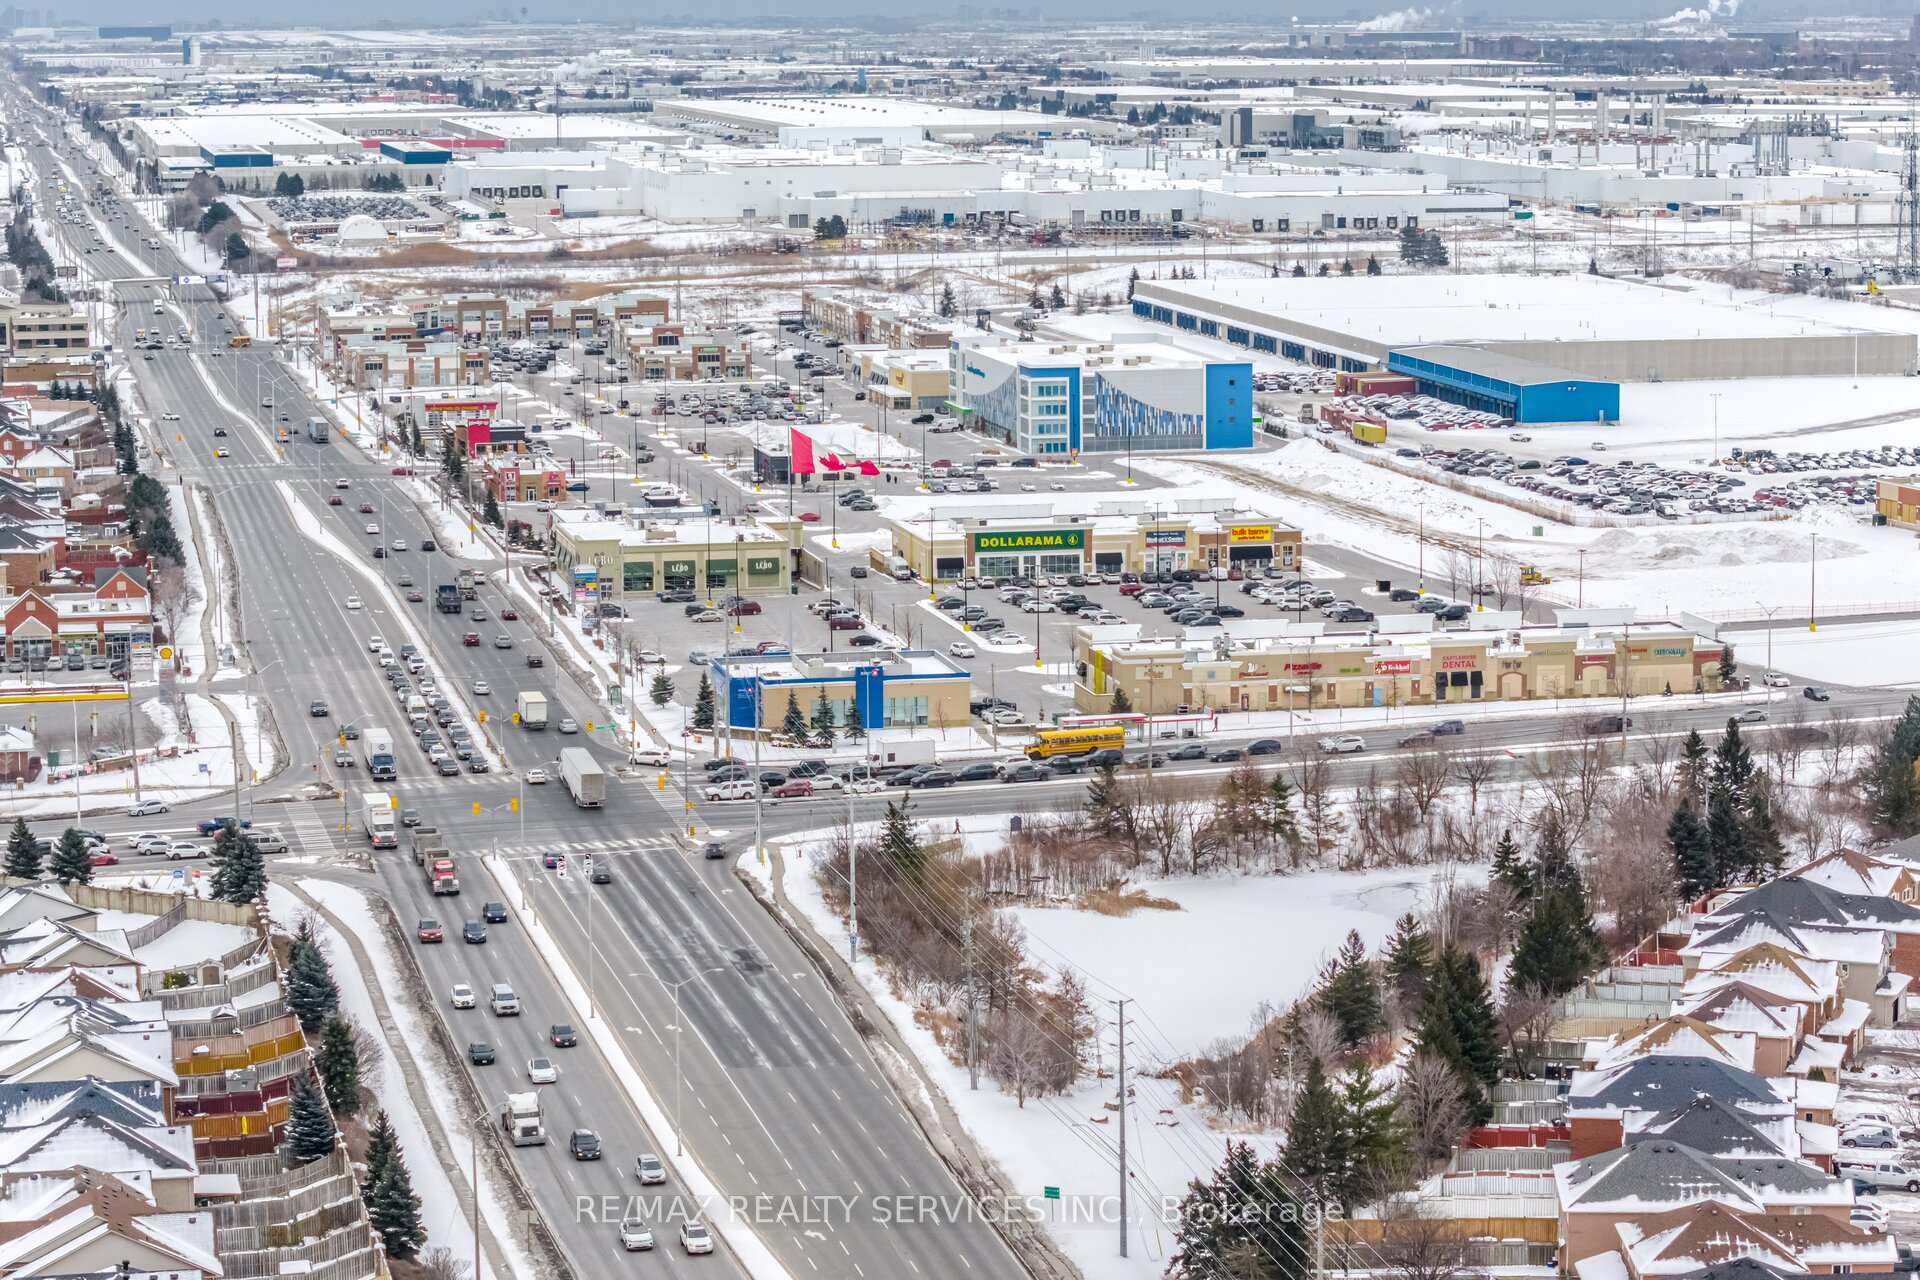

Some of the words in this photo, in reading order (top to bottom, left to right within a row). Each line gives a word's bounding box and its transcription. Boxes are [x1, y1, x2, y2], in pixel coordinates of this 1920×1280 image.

[981, 535, 1063, 547] DOLLARAMA
[671, 564, 689, 572] LCBO
[1442, 660, 1477, 669] DENTAL
